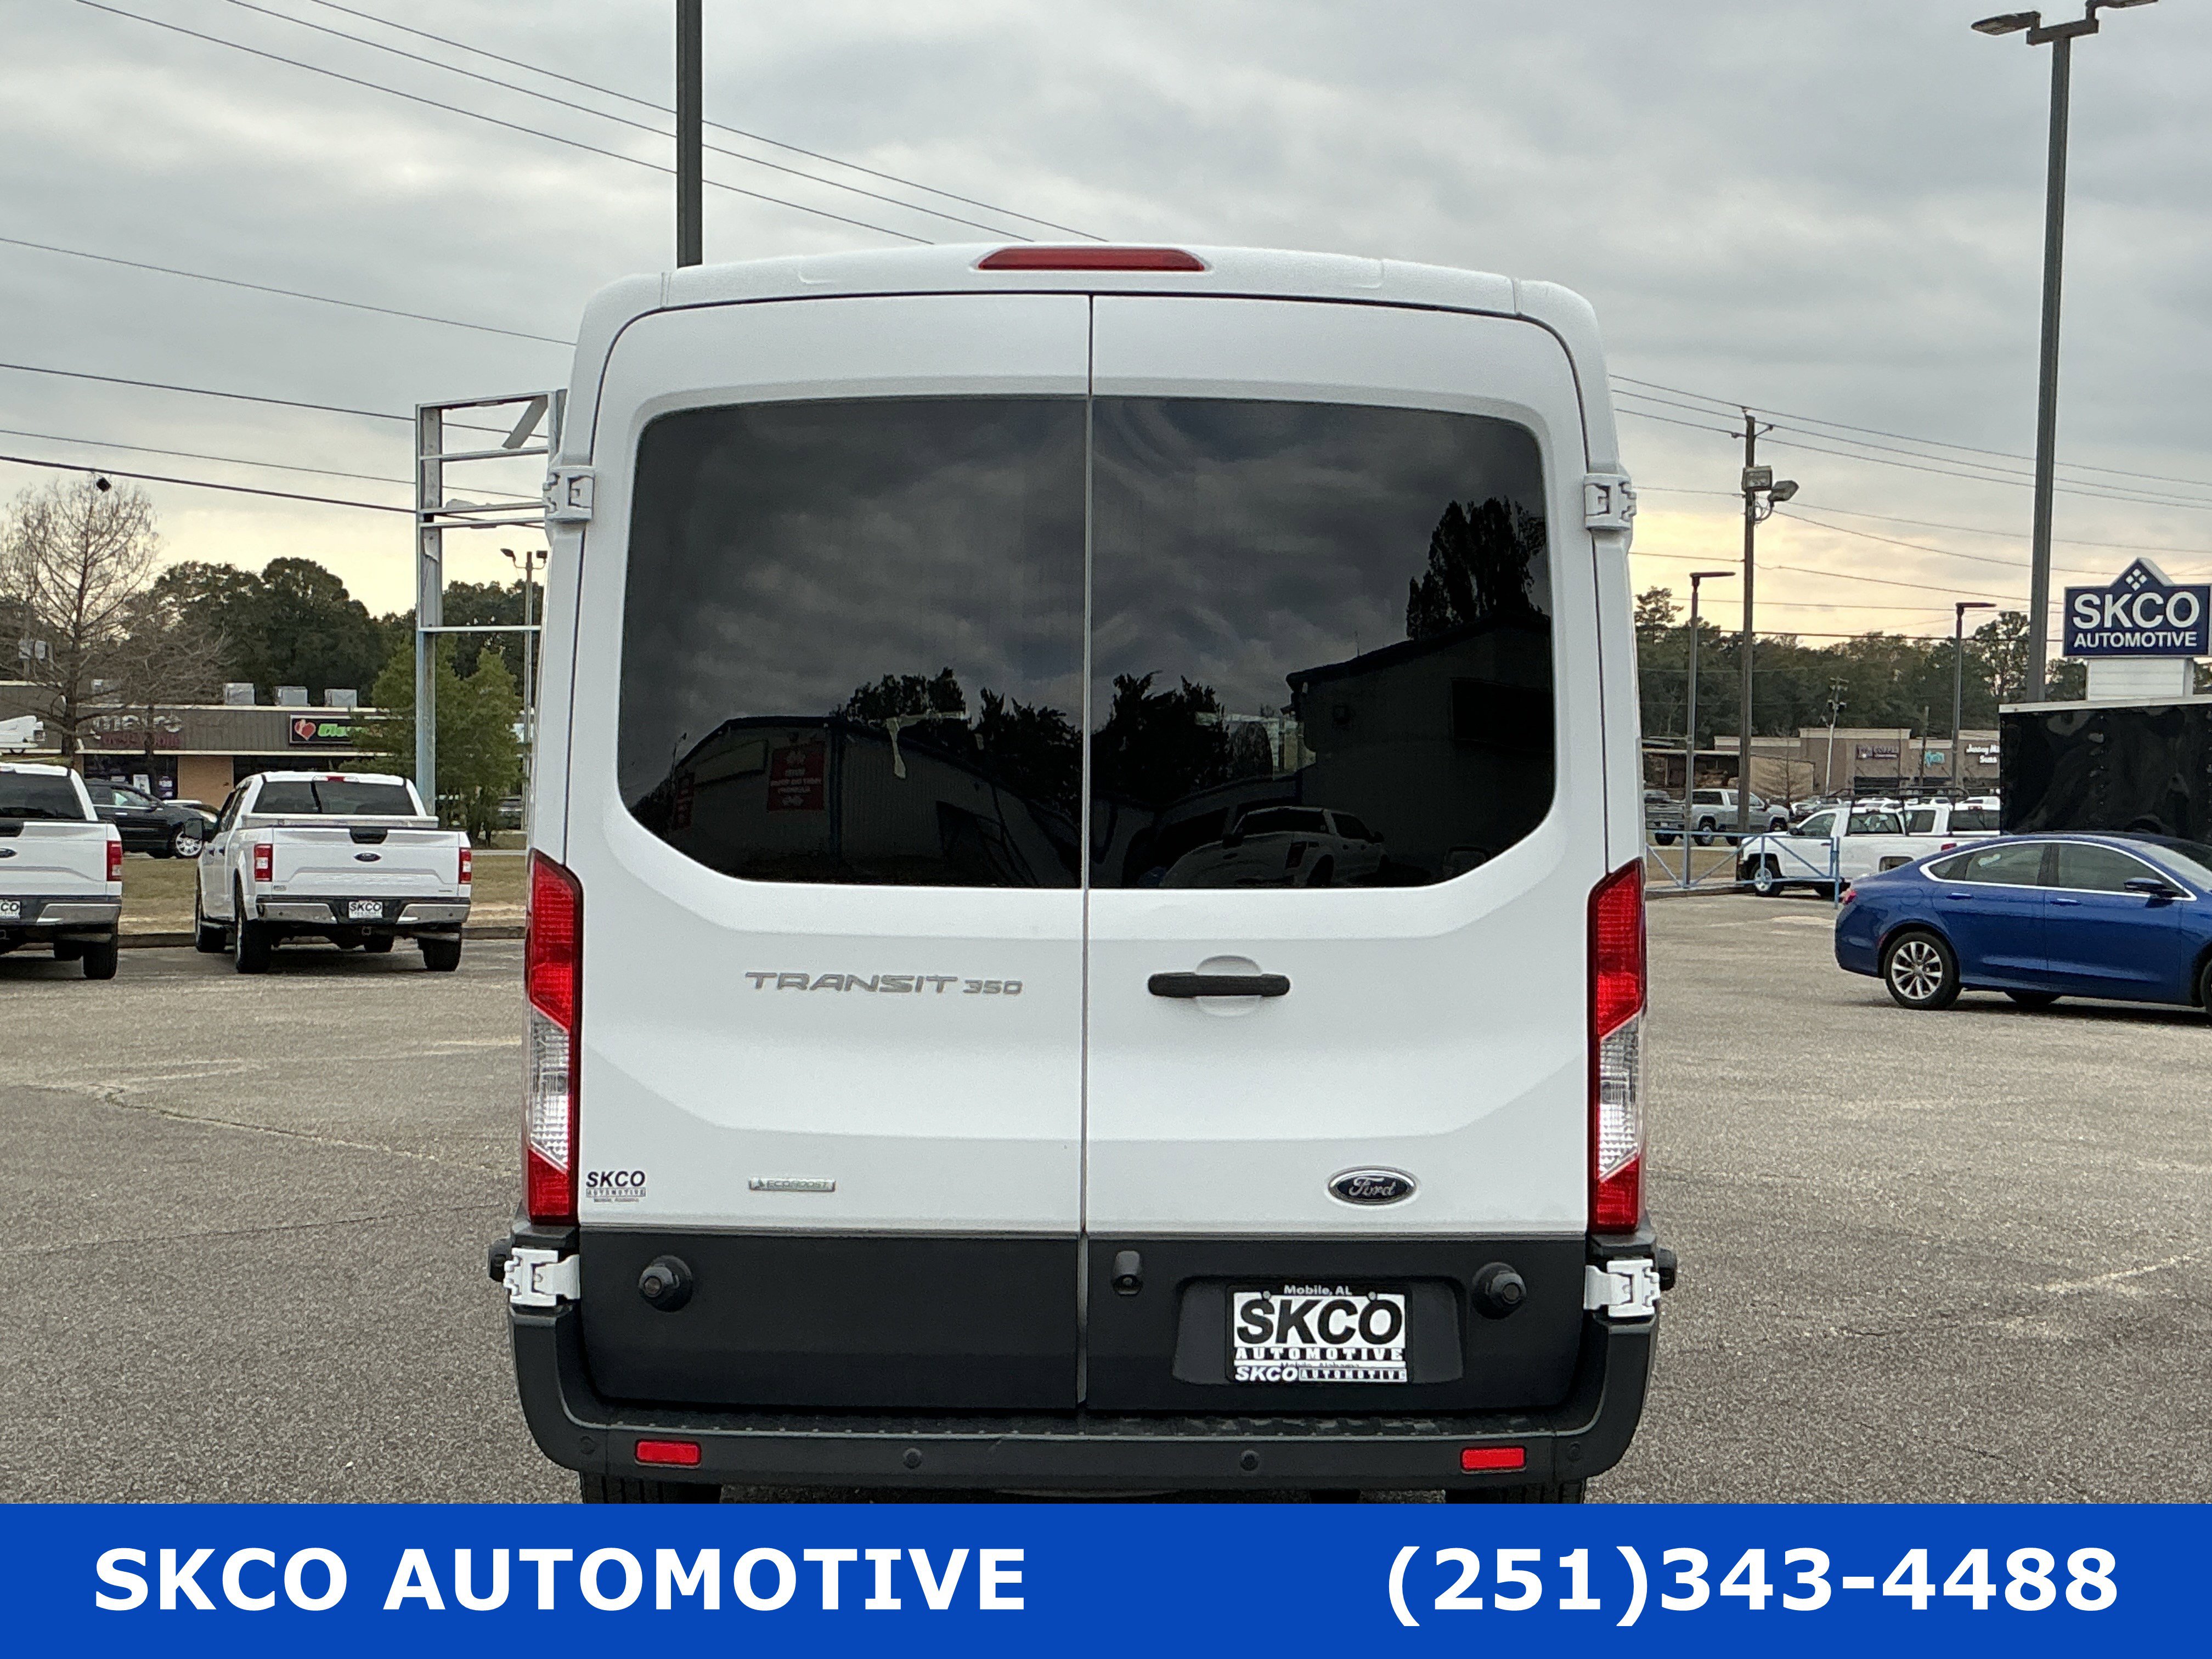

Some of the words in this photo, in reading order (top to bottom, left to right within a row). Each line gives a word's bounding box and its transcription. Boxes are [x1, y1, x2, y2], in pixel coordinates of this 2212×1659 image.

[2073, 591, 2200, 629] SKCO
[2074, 631, 2198, 648] AUTOMOTIVE
[0, 902, 19, 912] CO
[349, 902, 382, 912] SKCO
[744, 972, 959, 994] TRANSIT
[962, 979, 1023, 995] 350
[586, 1170, 645, 1187] SKCO
[1348, 1177, 1397, 1197] Ford
[1283, 1285, 1333, 1296] Mobile,
[1335, 1285, 1353, 1295] AL
[1237, 1298, 1403, 1345] SKCO
[1235, 1347, 1403, 1361] AUTOMOTIVE
[1235, 1366, 1299, 1381] SKCO
[1301, 1369, 1407, 1380] AUTOMOTIVE
